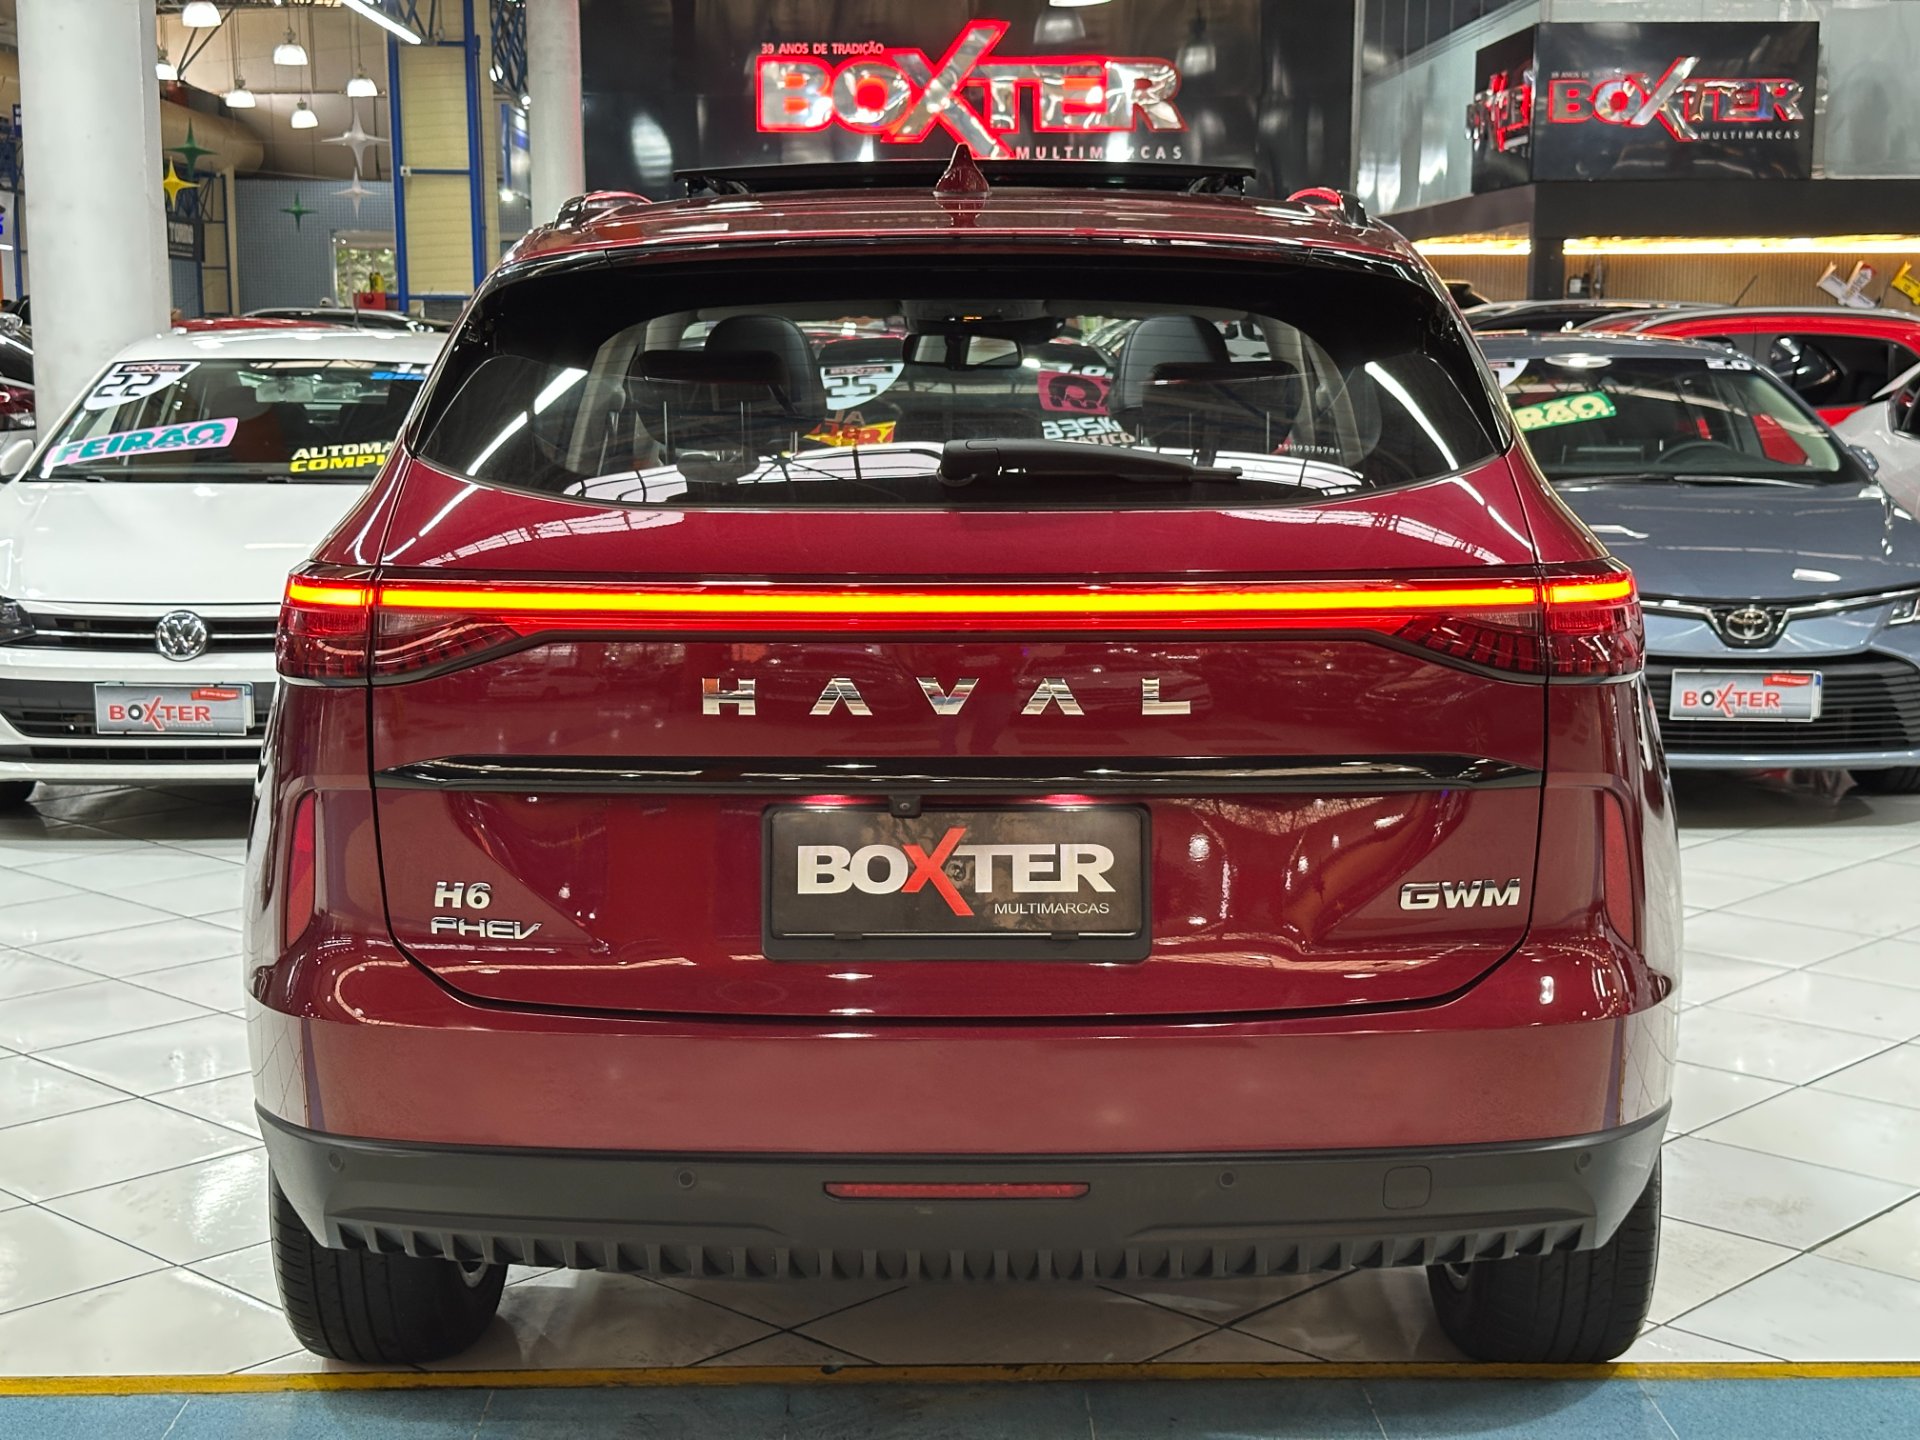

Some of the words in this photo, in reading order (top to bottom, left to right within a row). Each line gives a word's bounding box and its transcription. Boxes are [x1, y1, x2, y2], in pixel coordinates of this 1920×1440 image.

[761, 43, 774, 54] 39
[778, 43, 809, 54] ANOS
[812, 43, 828, 54] DE
[831, 41, 884, 56] TRADIÇÃO
[756, 19, 1190, 160] BOXTER
[1548, 56, 1804, 142] BOXTER
[1701, 130, 1800, 140] MULTIMARCAS
[1015, 146, 1183, 160] MULTIMCAS
[93, 374, 161, 398] 22
[52, 421, 228, 464] FEIRÃO
[108, 695, 212, 731] BOXTER
[702, 678, 1192, 716] HAVAL
[1681, 681, 1782, 718] BOXTER
[797, 826, 1116, 917] BOXTER
[434, 881, 492, 910] H6
[994, 902, 1110, 915] MULTIMARCAS
[1400, 878, 1520, 910] GWM
[430, 916, 543, 940] PHEV
